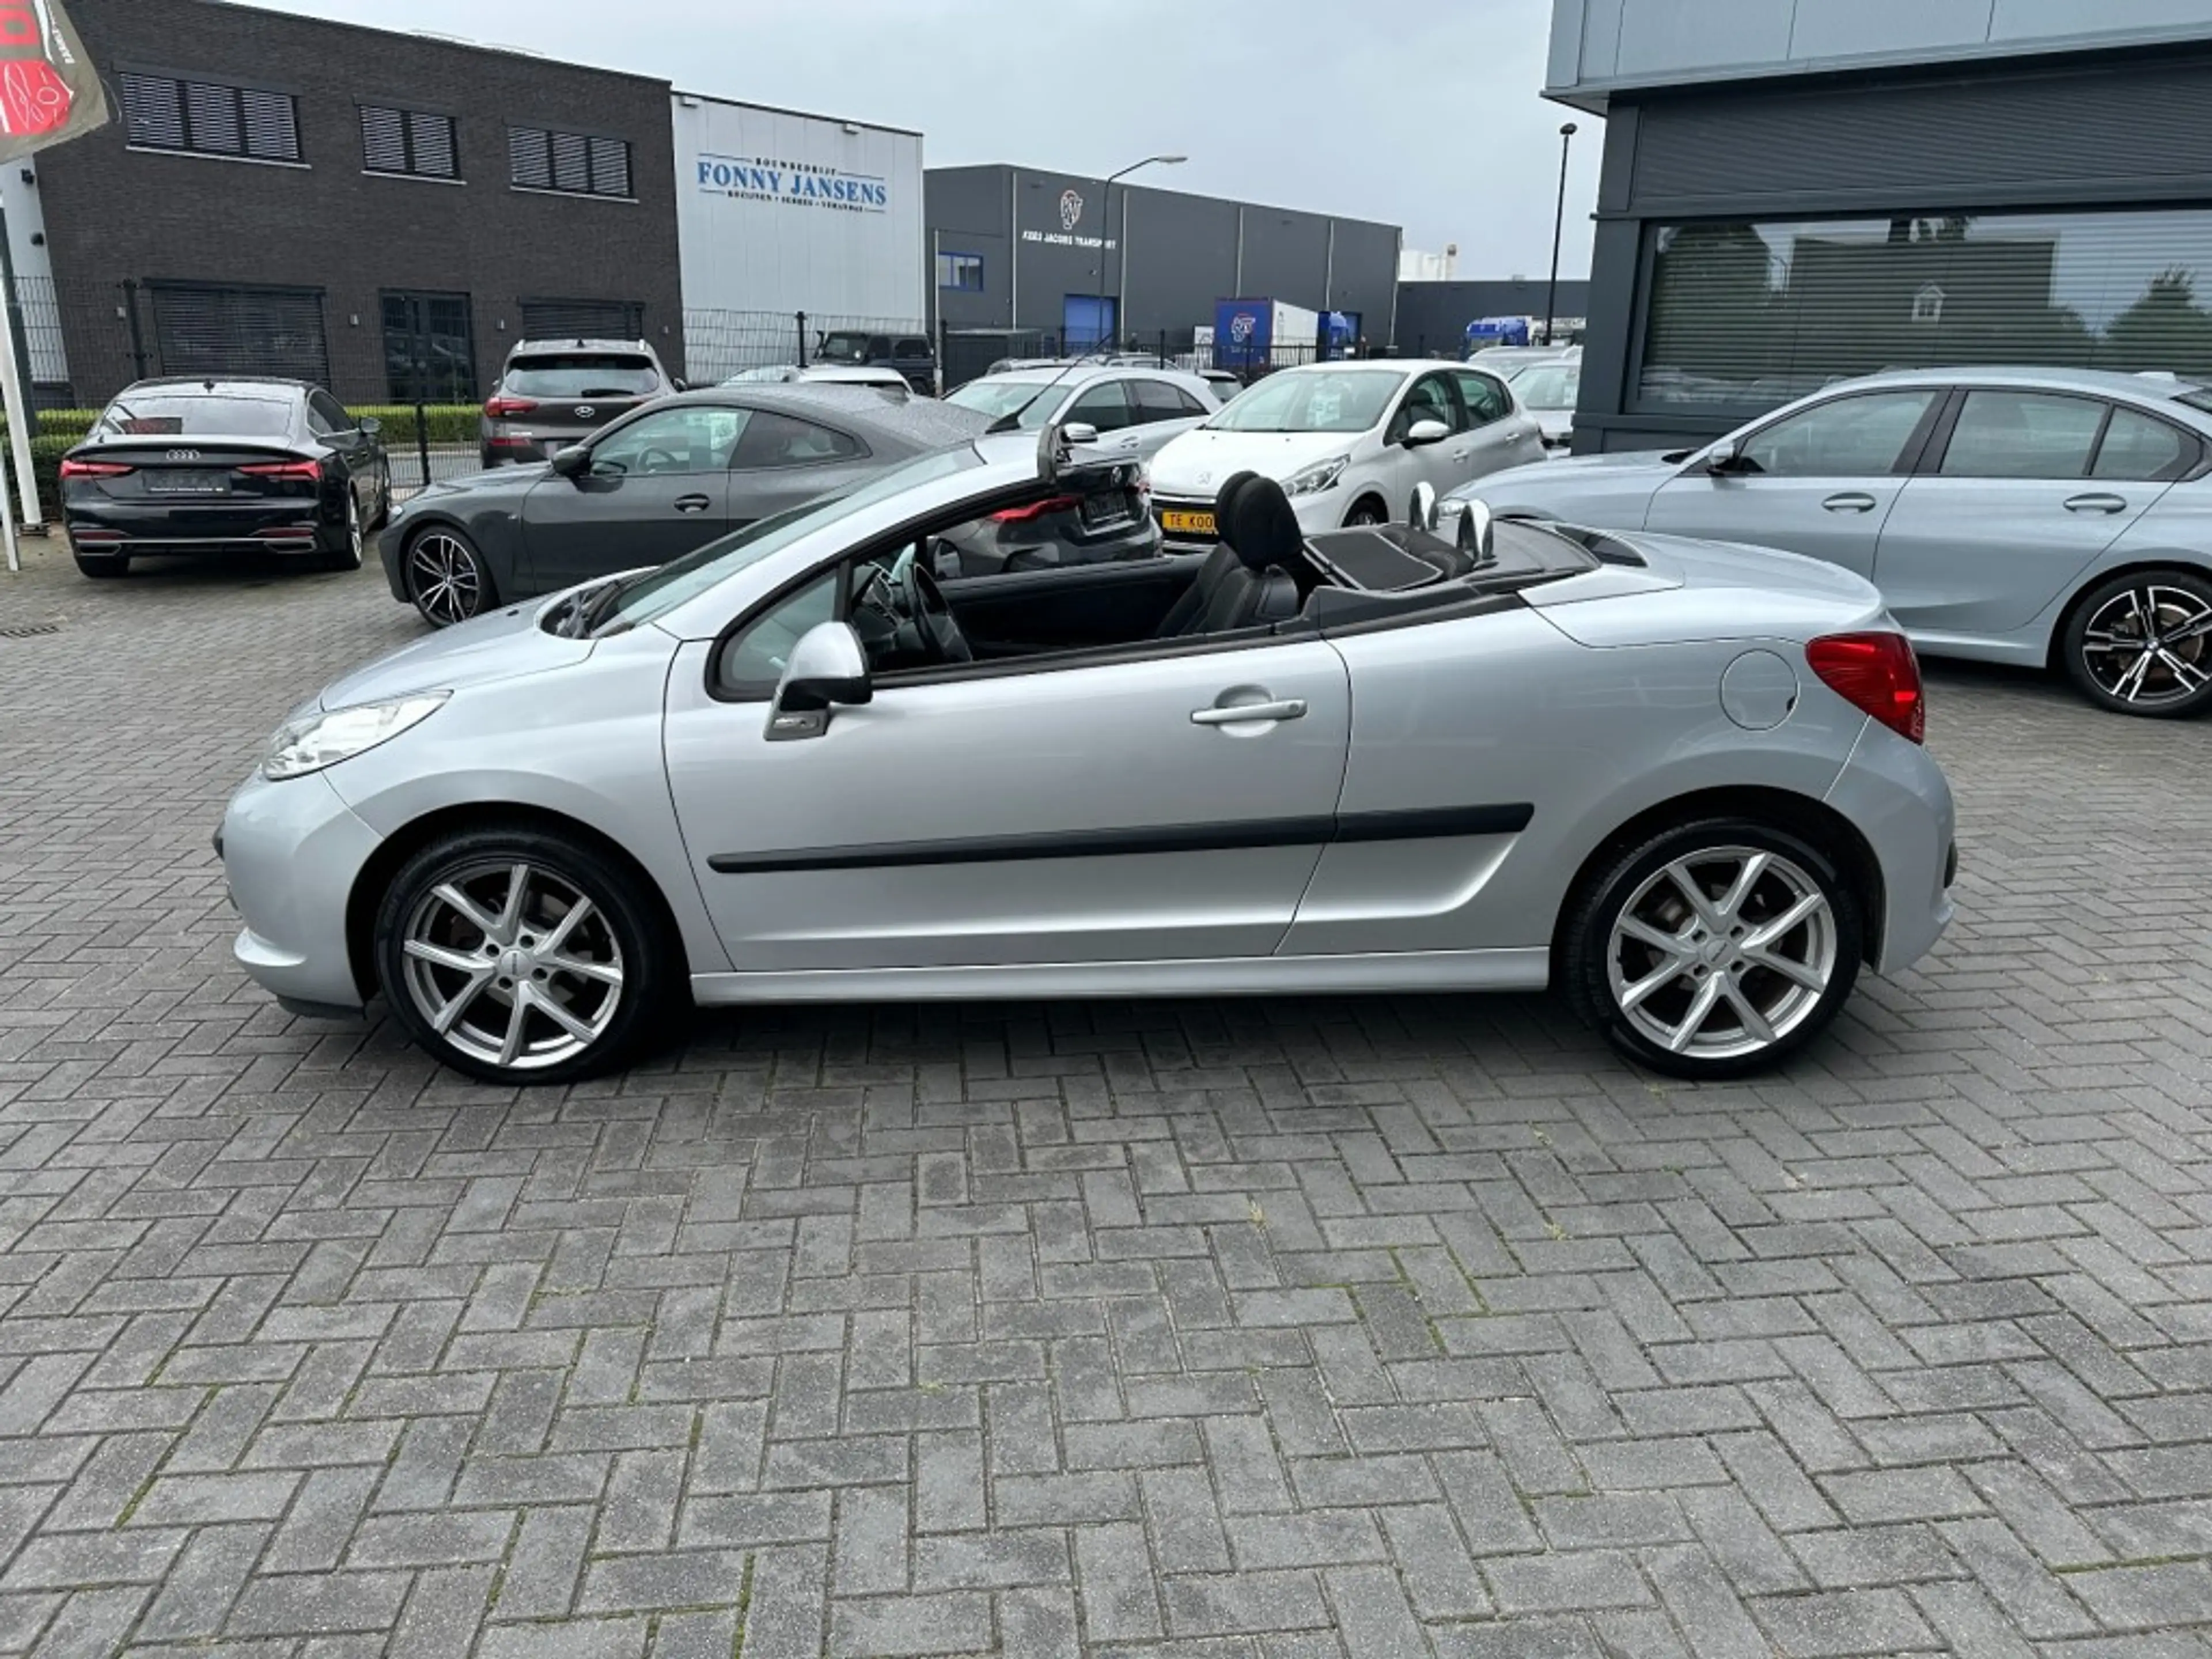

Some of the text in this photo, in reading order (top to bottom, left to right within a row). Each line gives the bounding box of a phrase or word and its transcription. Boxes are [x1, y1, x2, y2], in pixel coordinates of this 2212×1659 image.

[756, 157, 836, 176] BOUWBEDRIJF
[697, 161, 887, 206] FONNY JANSENS
[1170, 514, 1217, 528] TE KOO
